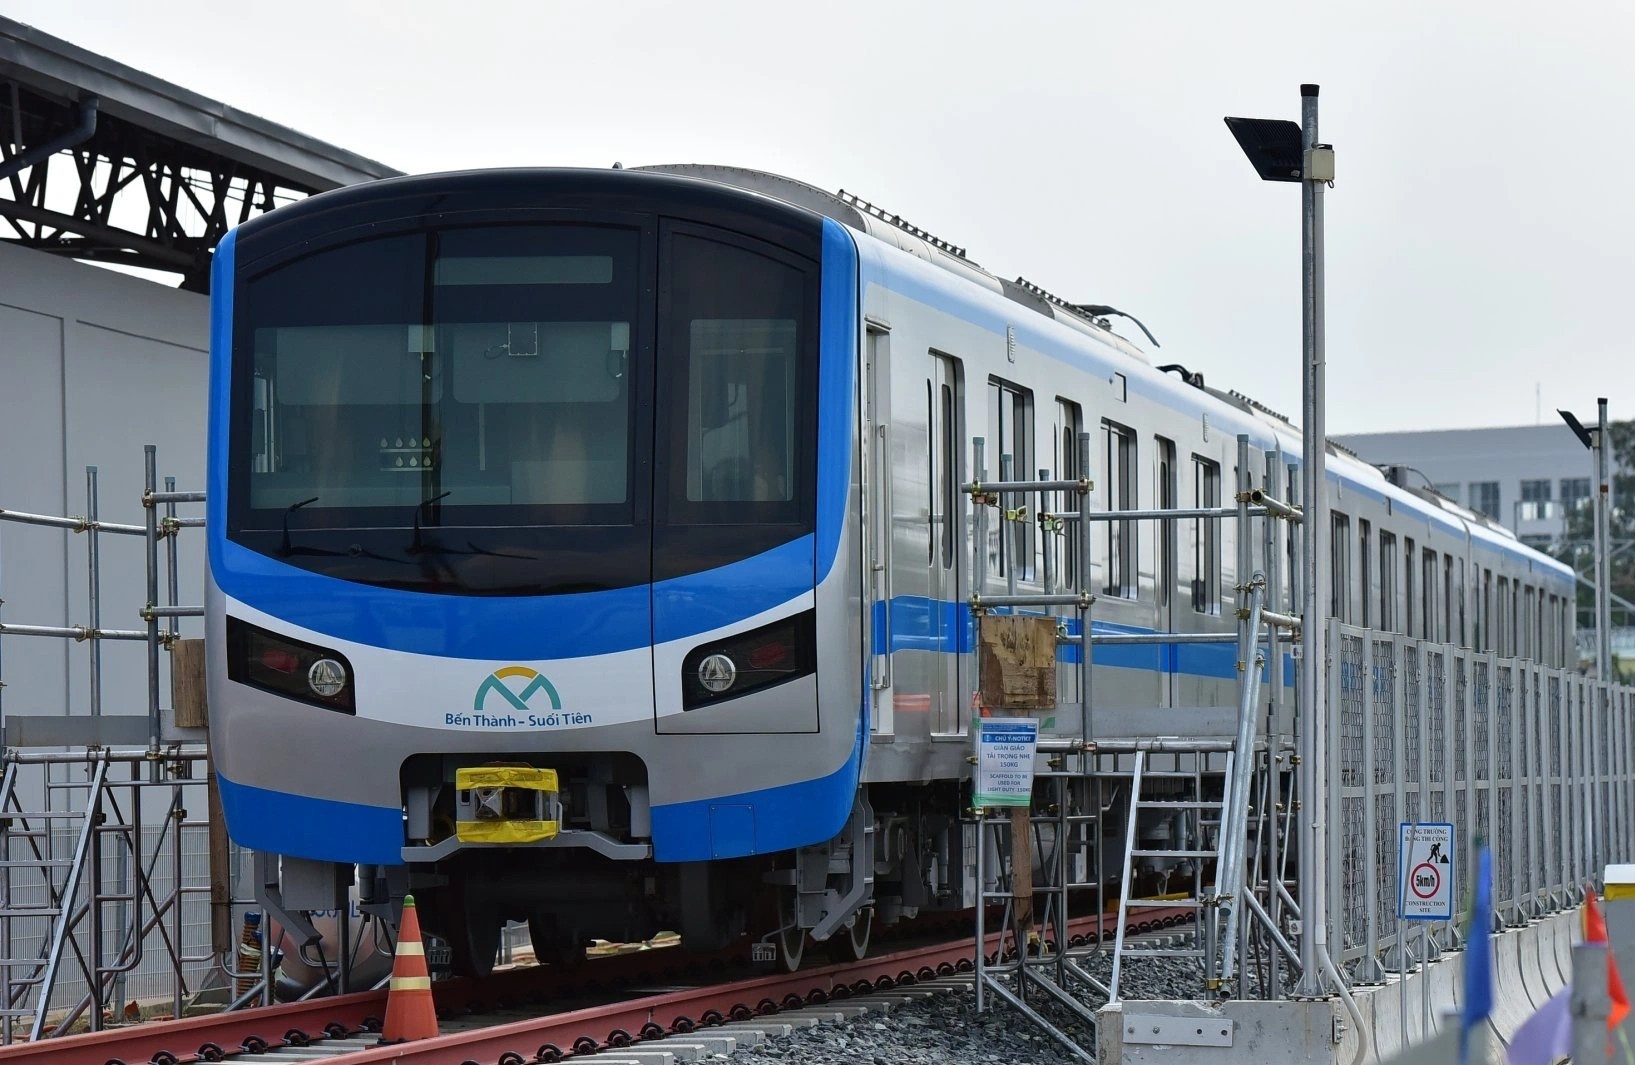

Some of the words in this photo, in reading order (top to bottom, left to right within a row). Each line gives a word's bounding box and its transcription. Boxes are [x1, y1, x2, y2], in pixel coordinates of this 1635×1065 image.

[445, 713, 471, 726] Bến
[473, 715, 516, 727] Thành
[529, 714, 560, 726] Suối
[562, 712, 593, 725] Tiên
[1416, 874, 1436, 888] 5km/h
